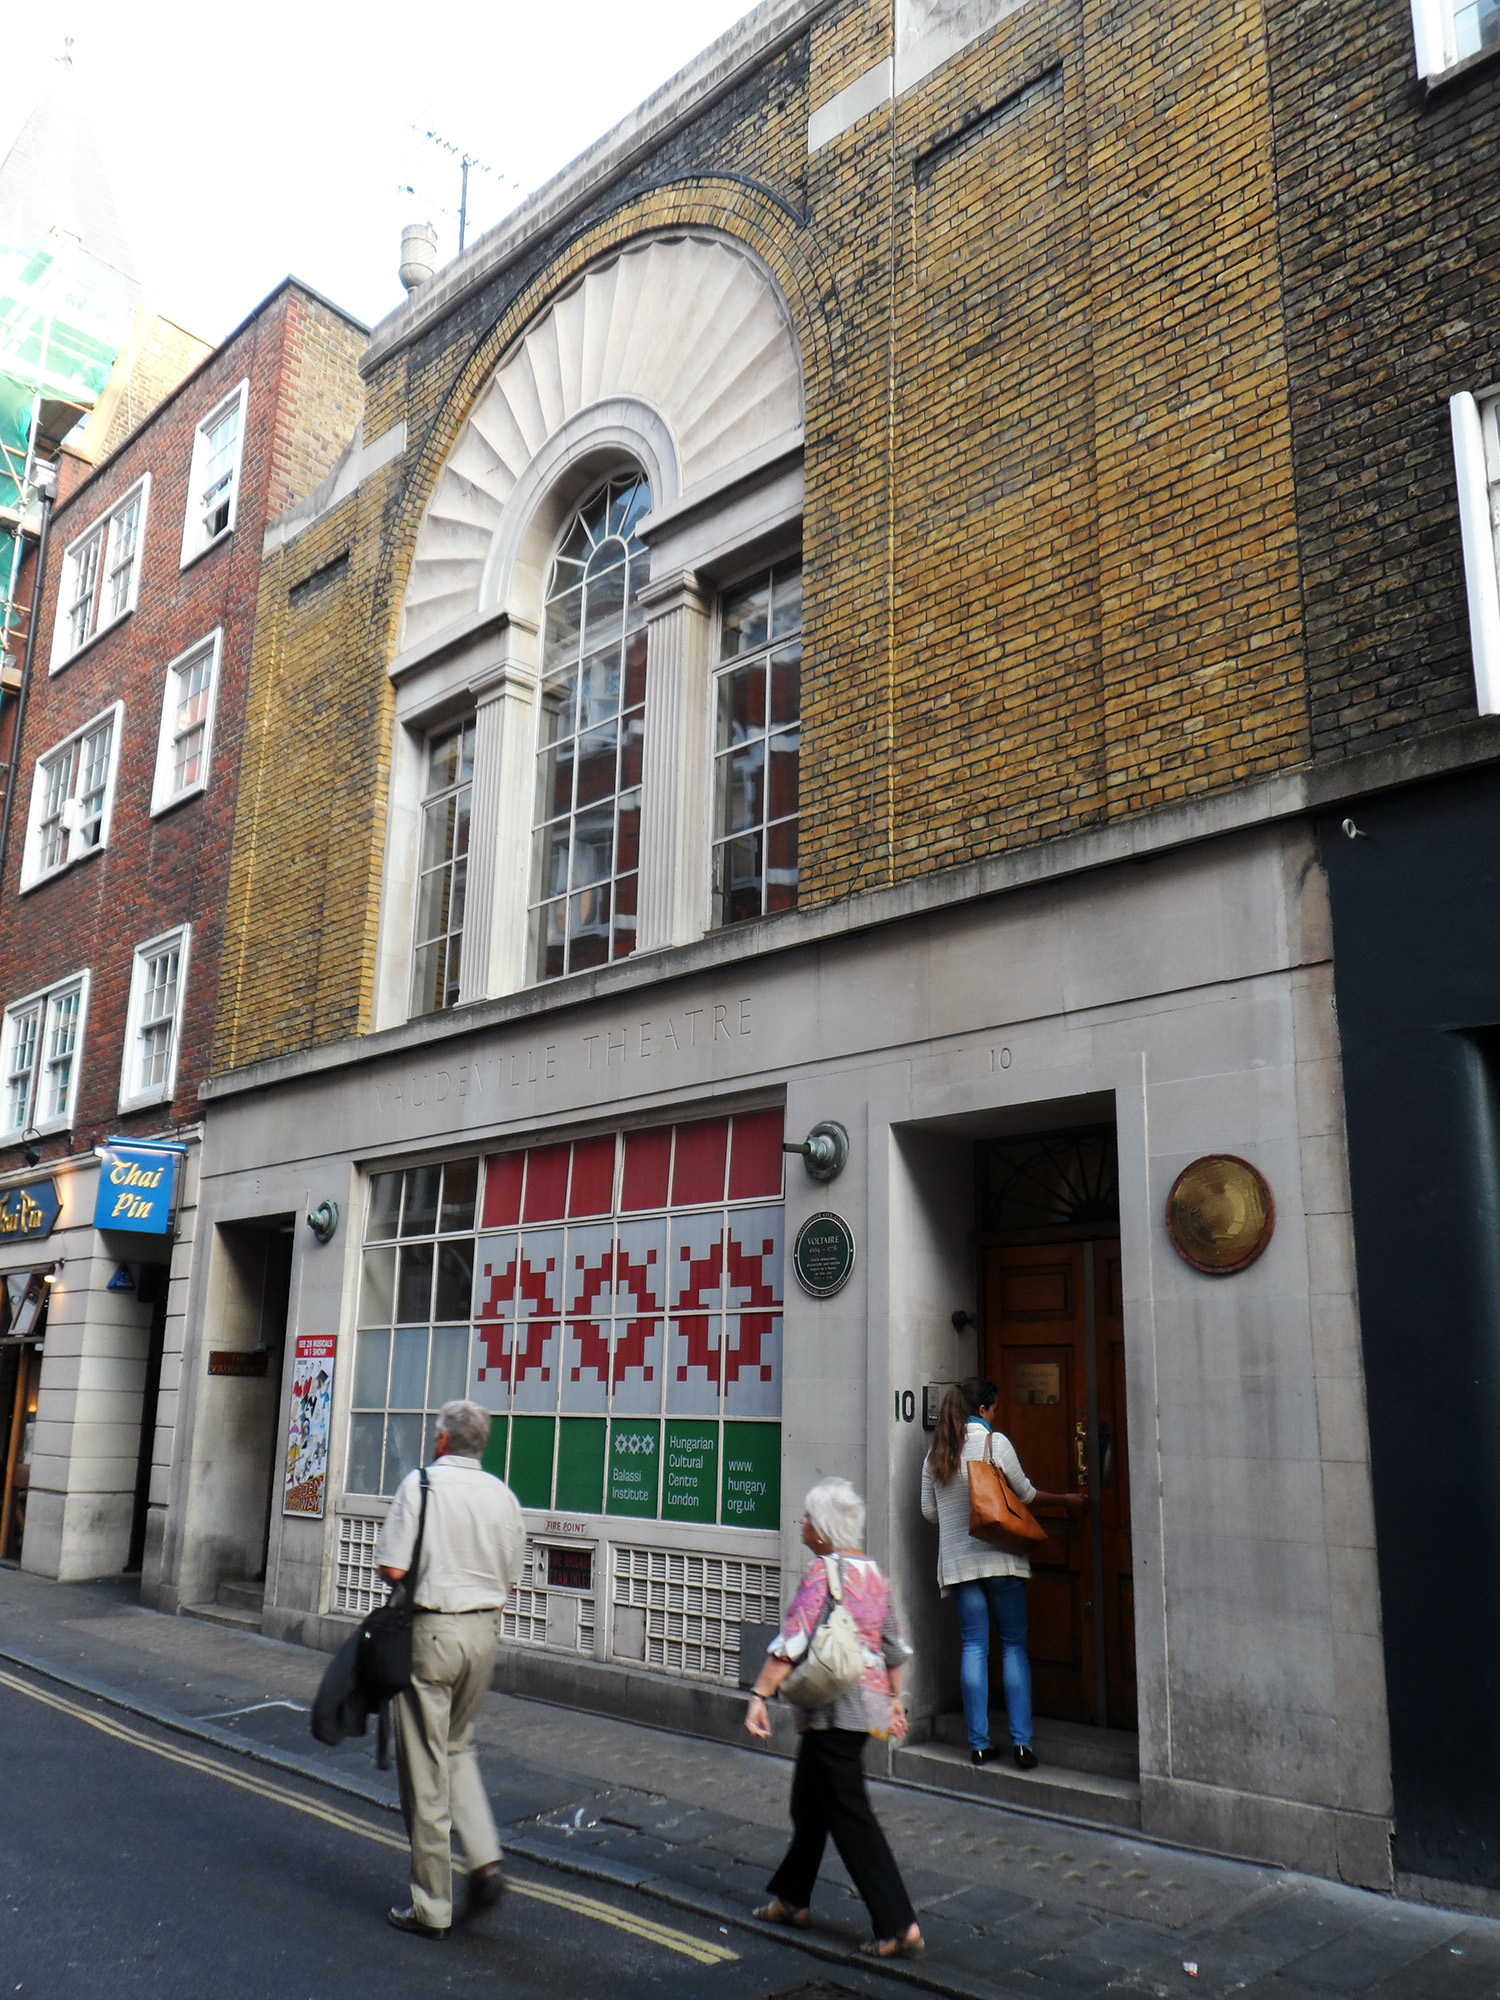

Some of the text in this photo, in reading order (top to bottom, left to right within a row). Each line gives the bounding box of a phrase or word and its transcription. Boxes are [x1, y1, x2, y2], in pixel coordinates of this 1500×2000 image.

[583, 998, 751, 1070] THEATRE
[990, 1047, 1012, 1072] 10
[109, 1160, 165, 1189] Thai
[111, 1192, 154, 1219] Pin
[807, 1235, 840, 1246] VOLTAIRE
[894, 1390, 916, 1423] 10
[669, 1435, 714, 1453] Hungarian
[668, 1454, 704, 1469] Cultural
[728, 1460, 754, 1472] www.
[613, 1468, 642, 1483] Balassi
[668, 1473, 698, 1488] Centre
[612, 1486, 649, 1502] Institute
[727, 1476, 767, 1496] hungary.
[667, 1492, 699, 1507] London
[727, 1498, 756, 1514] org.uk
[546, 1521, 586, 1533] FIRE POINT
